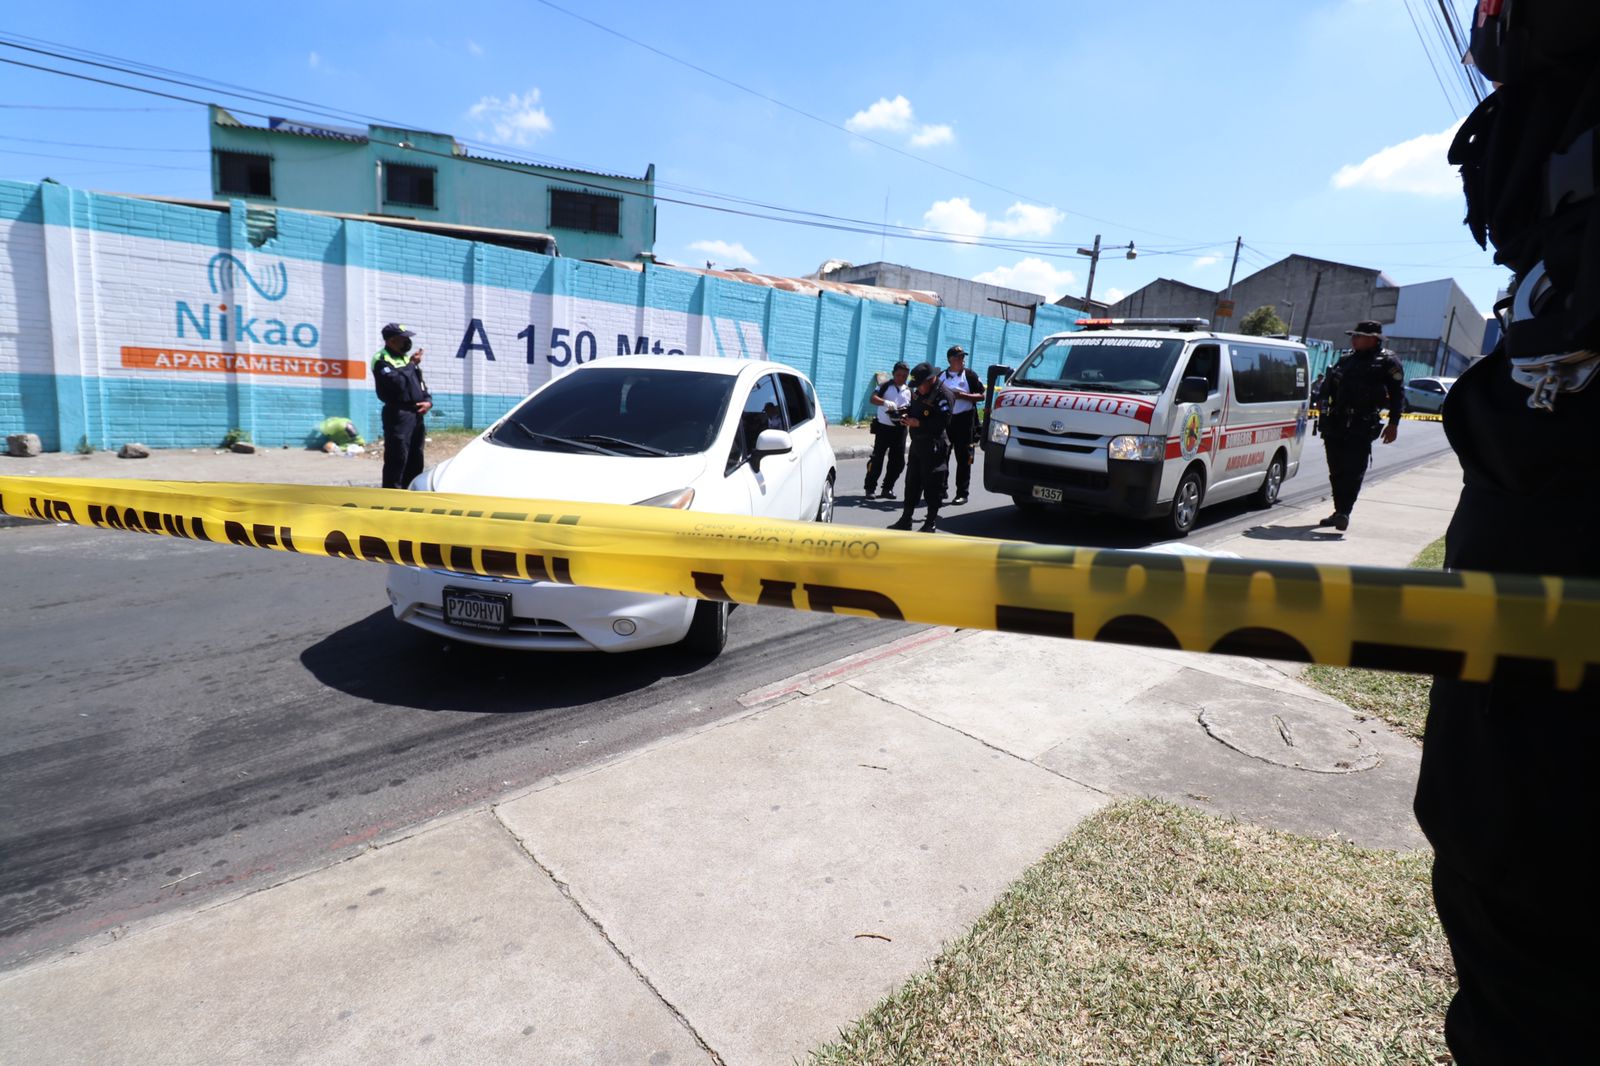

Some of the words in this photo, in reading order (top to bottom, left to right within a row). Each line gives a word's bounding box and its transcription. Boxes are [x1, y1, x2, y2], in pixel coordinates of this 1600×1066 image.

[176, 301, 319, 348] Nikao
[455, 318, 496, 361] A
[517, 325, 597, 367] 150
[1101, 339, 1163, 348] VOLUNTARIOS
[155, 352, 342, 376] APARTAMENTOS
[1226, 451, 1266, 471] AMBULANCIA
[1040, 488, 1062, 500] 1357
